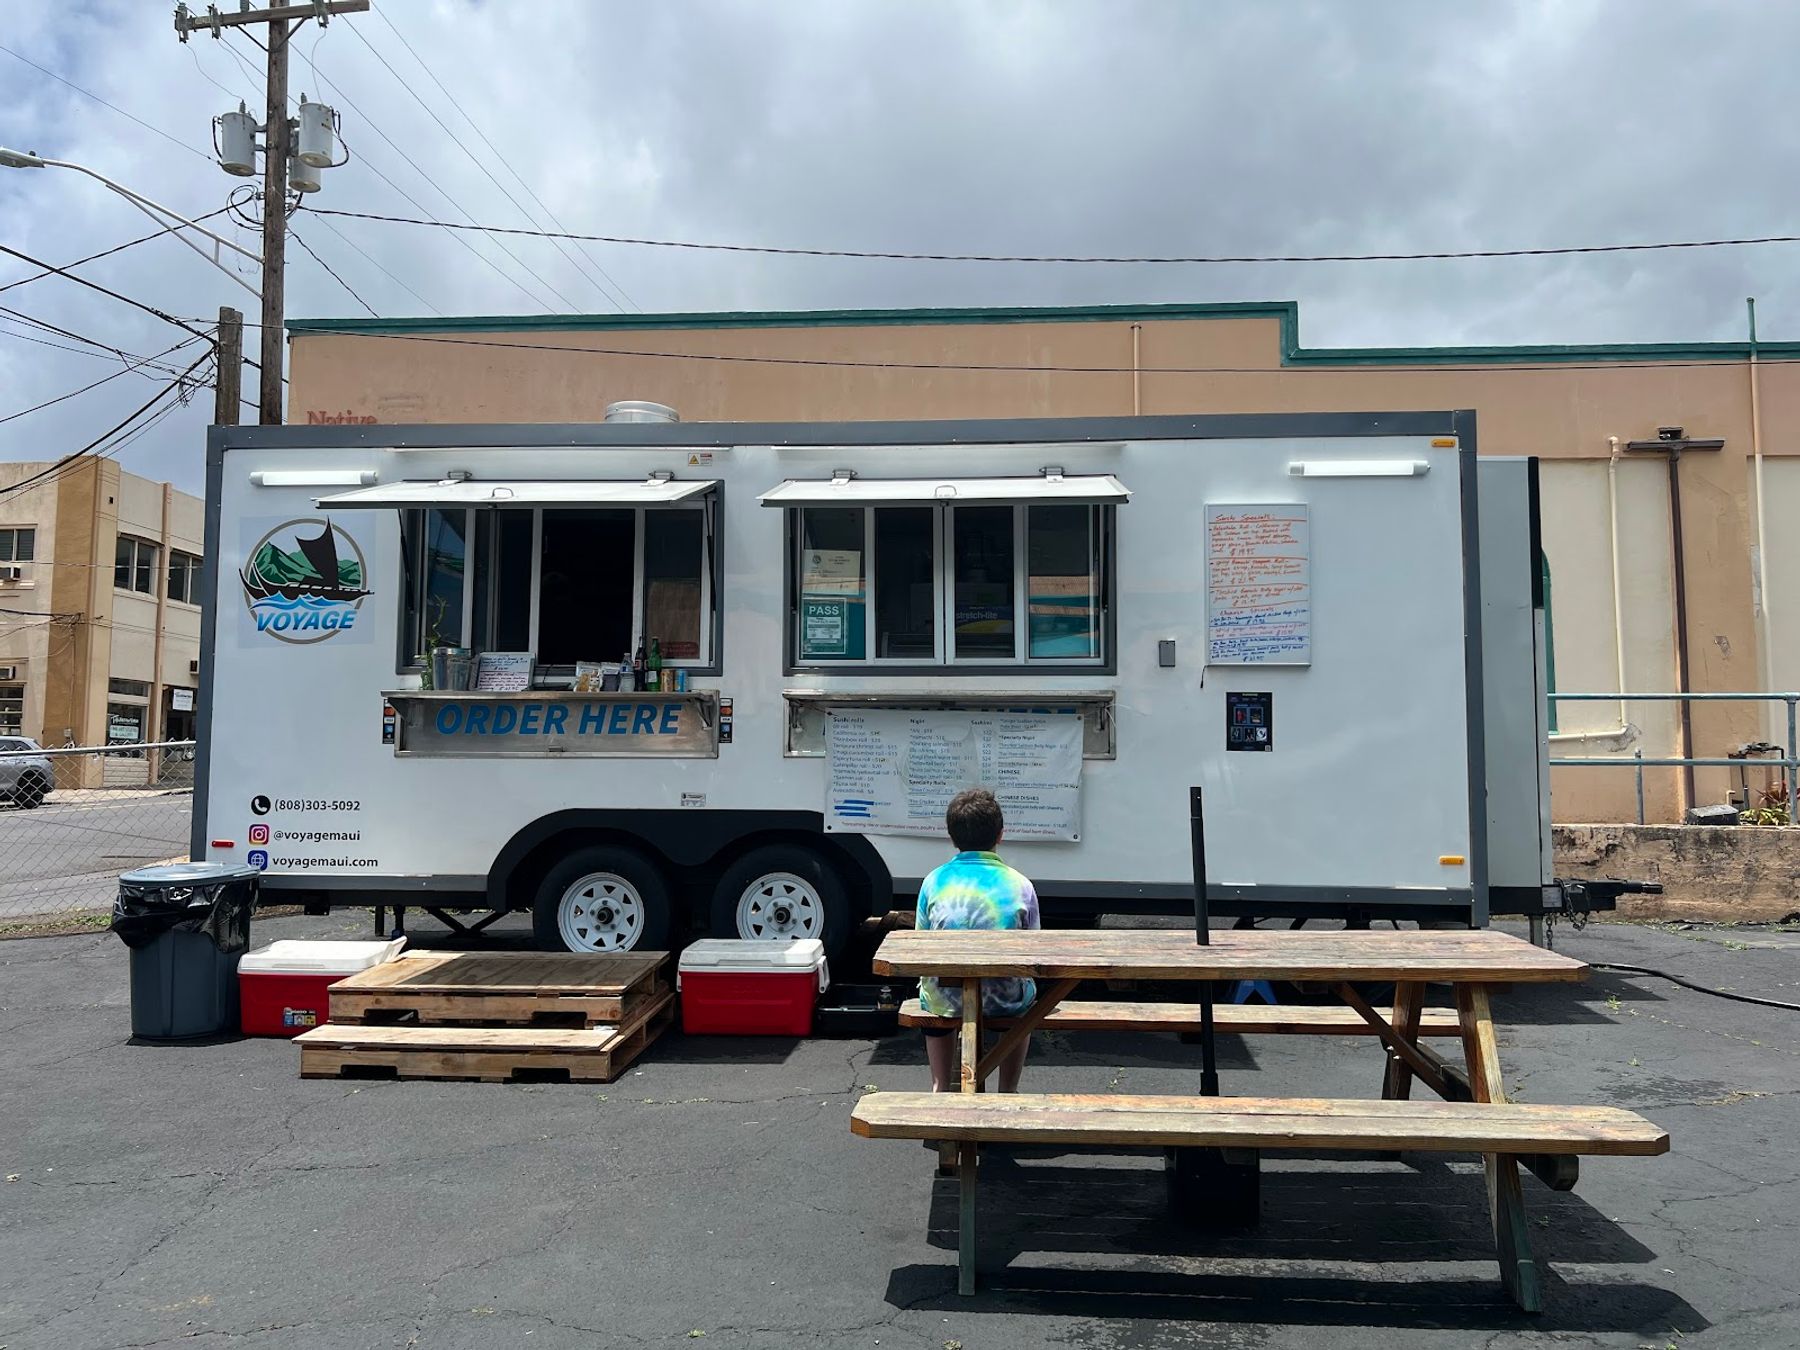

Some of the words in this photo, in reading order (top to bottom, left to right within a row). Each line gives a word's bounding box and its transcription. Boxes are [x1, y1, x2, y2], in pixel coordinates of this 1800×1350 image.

[307, 410, 378, 424] Native
[809, 606, 839, 615] PASS
[257, 610, 357, 631] VOYAGE
[436, 704, 569, 735] ORDER
[579, 704, 682, 735] HERE
[275, 799, 360, 812] (808)303-5092
[274, 831, 360, 842] @voyagemaui
[273, 857, 378, 868] voyagemaui.com
